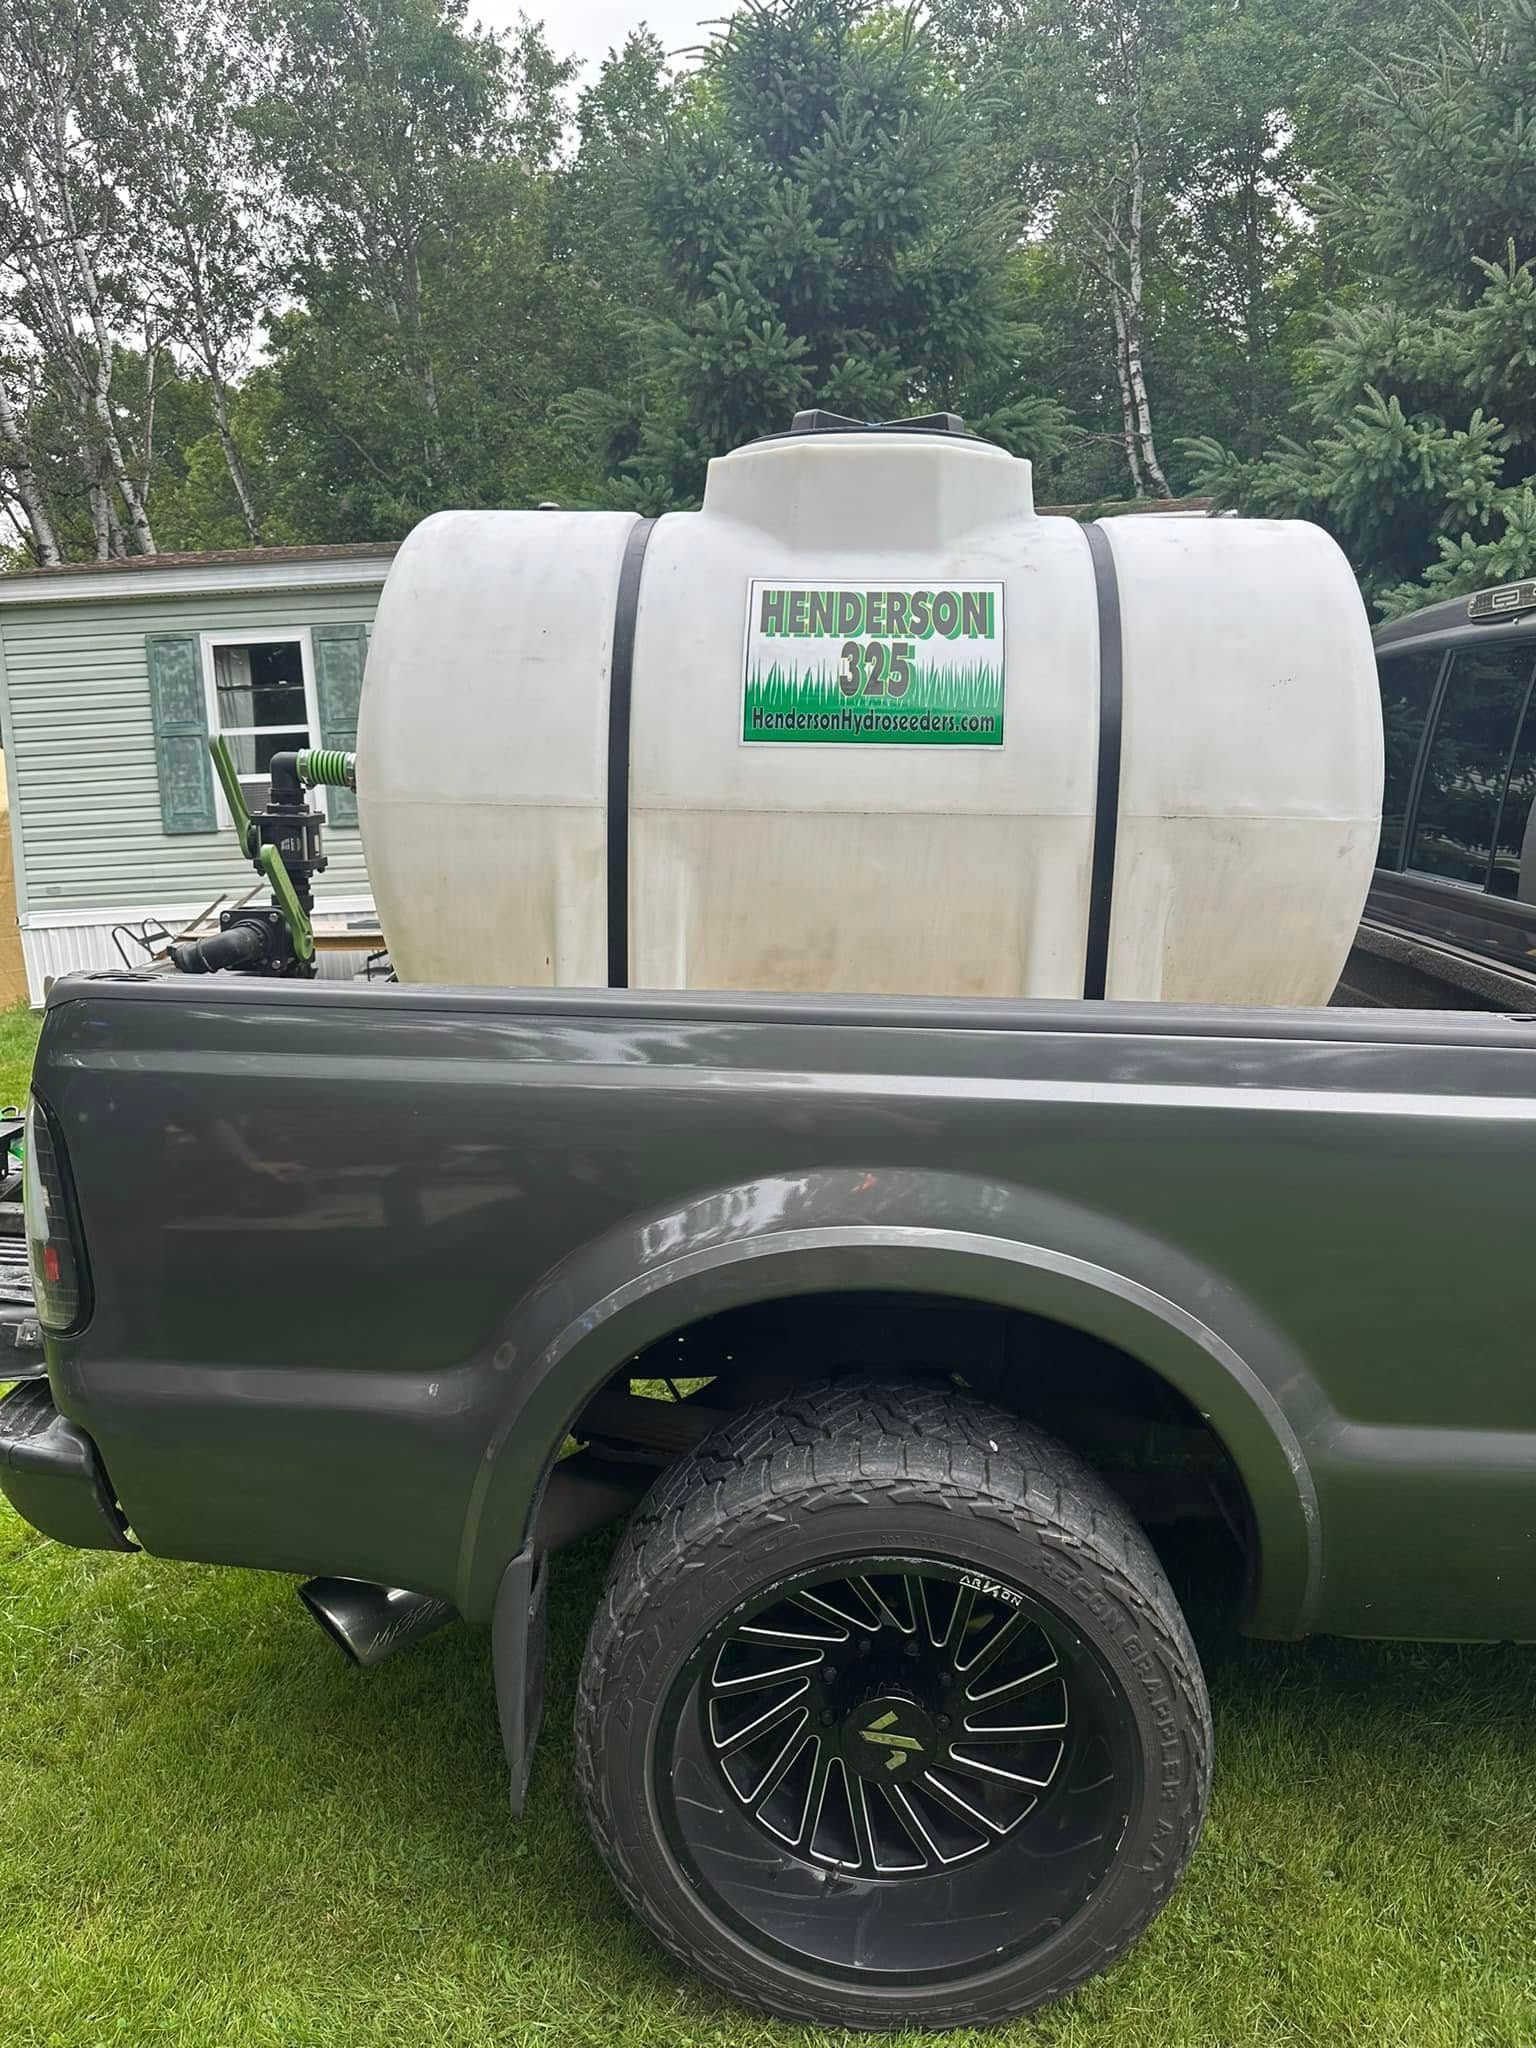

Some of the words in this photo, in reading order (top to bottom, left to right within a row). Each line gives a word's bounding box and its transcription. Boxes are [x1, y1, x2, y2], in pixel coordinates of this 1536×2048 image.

[760, 590, 994, 639] HENDERSON
[839, 641, 914, 698] 325
[752, 707, 994, 735] HendersonHydroseeders.com
